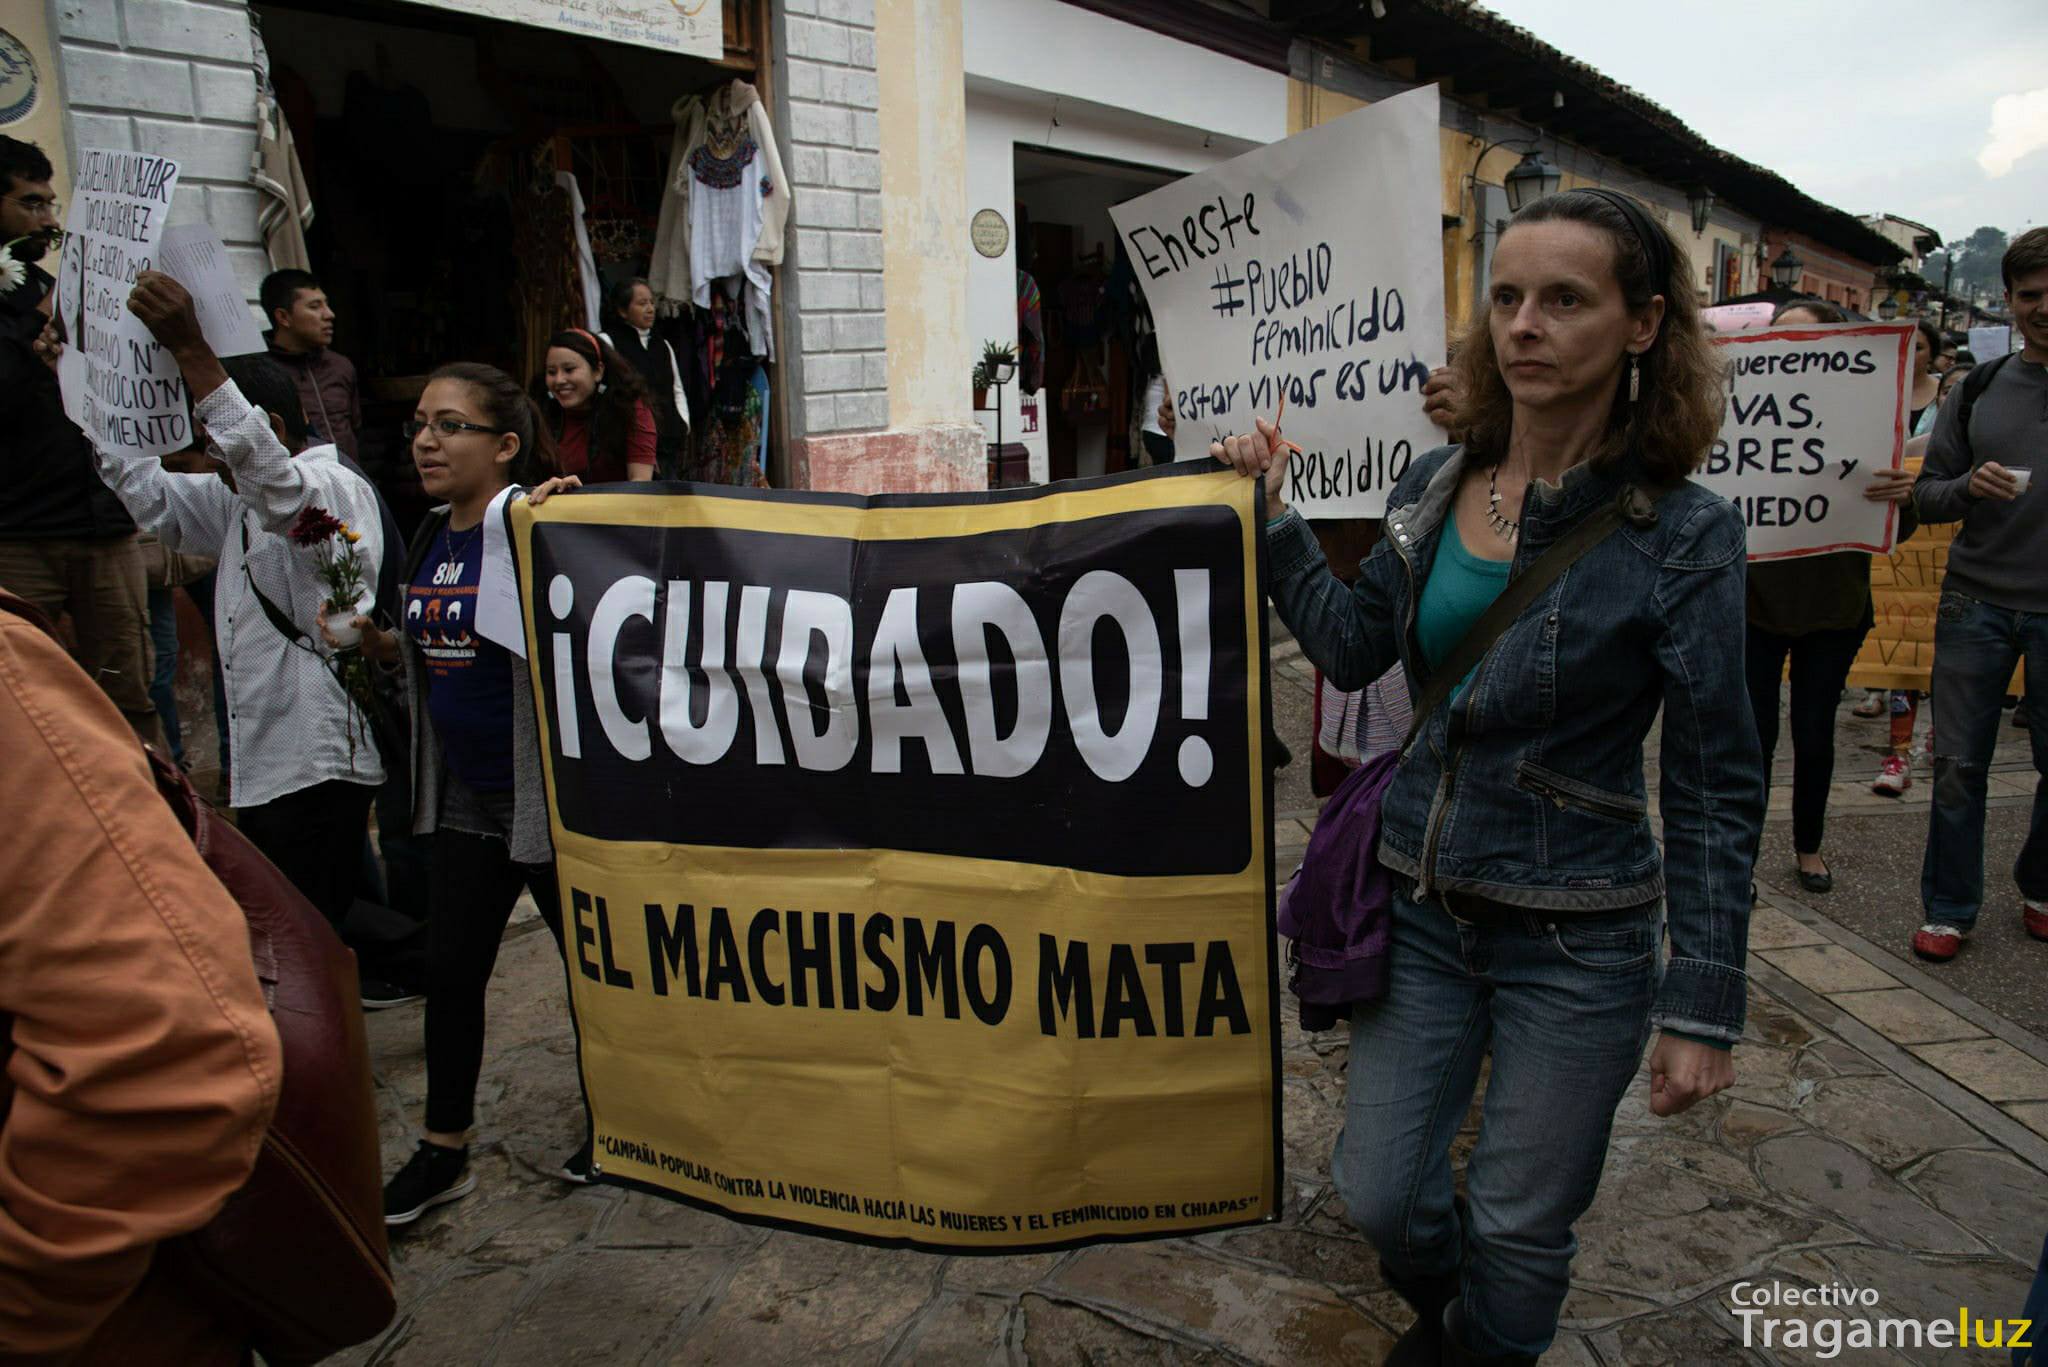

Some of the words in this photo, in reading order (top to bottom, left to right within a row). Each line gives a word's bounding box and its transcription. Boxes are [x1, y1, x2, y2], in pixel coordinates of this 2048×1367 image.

[1177, 382, 1241, 421] estar
[432, 562, 464, 584] 8M
[549, 568, 1215, 788] ¡CUIDADO!
[571, 886, 634, 989] EL
[644, 904, 1013, 1026] MACHISMO
[1039, 932, 1251, 1039] MATA
[660, 1153, 712, 1185] POPULAR
[714, 1171, 764, 1198] CONTRA
[768, 1180, 786, 1200] LA
[789, 1183, 860, 1214] VIOLENCIA
[863, 1197, 906, 1220] HACIA
[909, 1203, 935, 1226] LAS
[940, 1210, 1008, 1232] MUJERES
[1013, 1215, 1023, 1232] Y
[1028, 1214, 1048, 1230] EL
[1053, 1203, 1150, 1228] FEMINICIDIO
[1155, 1203, 1176, 1219] EN
